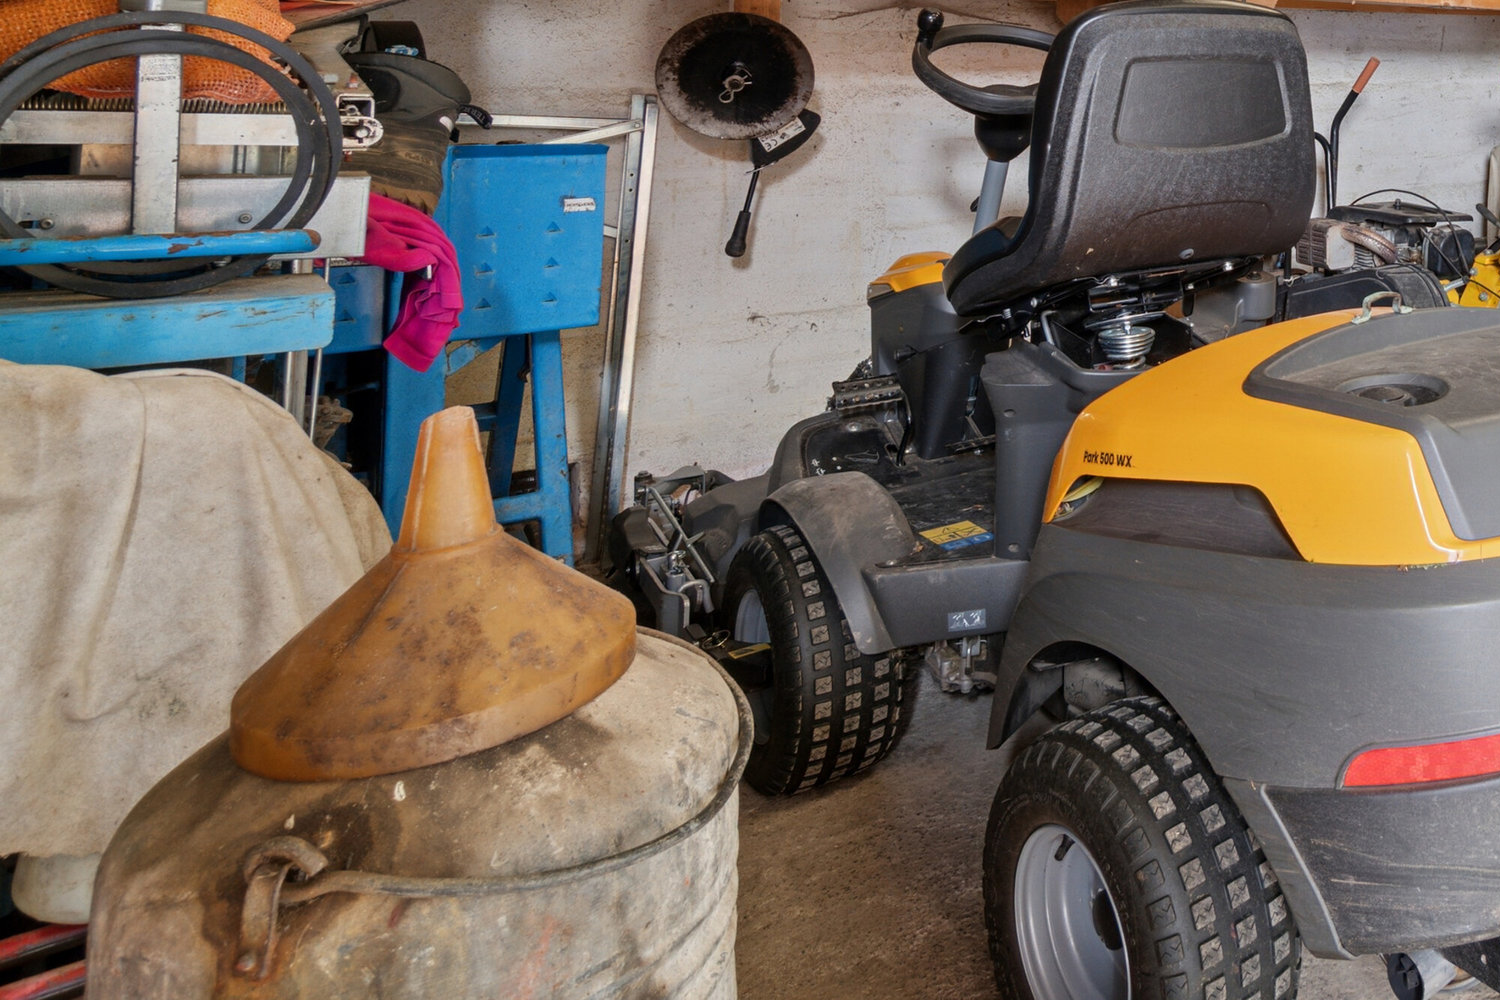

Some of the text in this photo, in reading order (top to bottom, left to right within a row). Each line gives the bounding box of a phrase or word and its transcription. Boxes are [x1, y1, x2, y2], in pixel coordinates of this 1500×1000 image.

[1083, 450, 1133, 467] Park 500 WX
